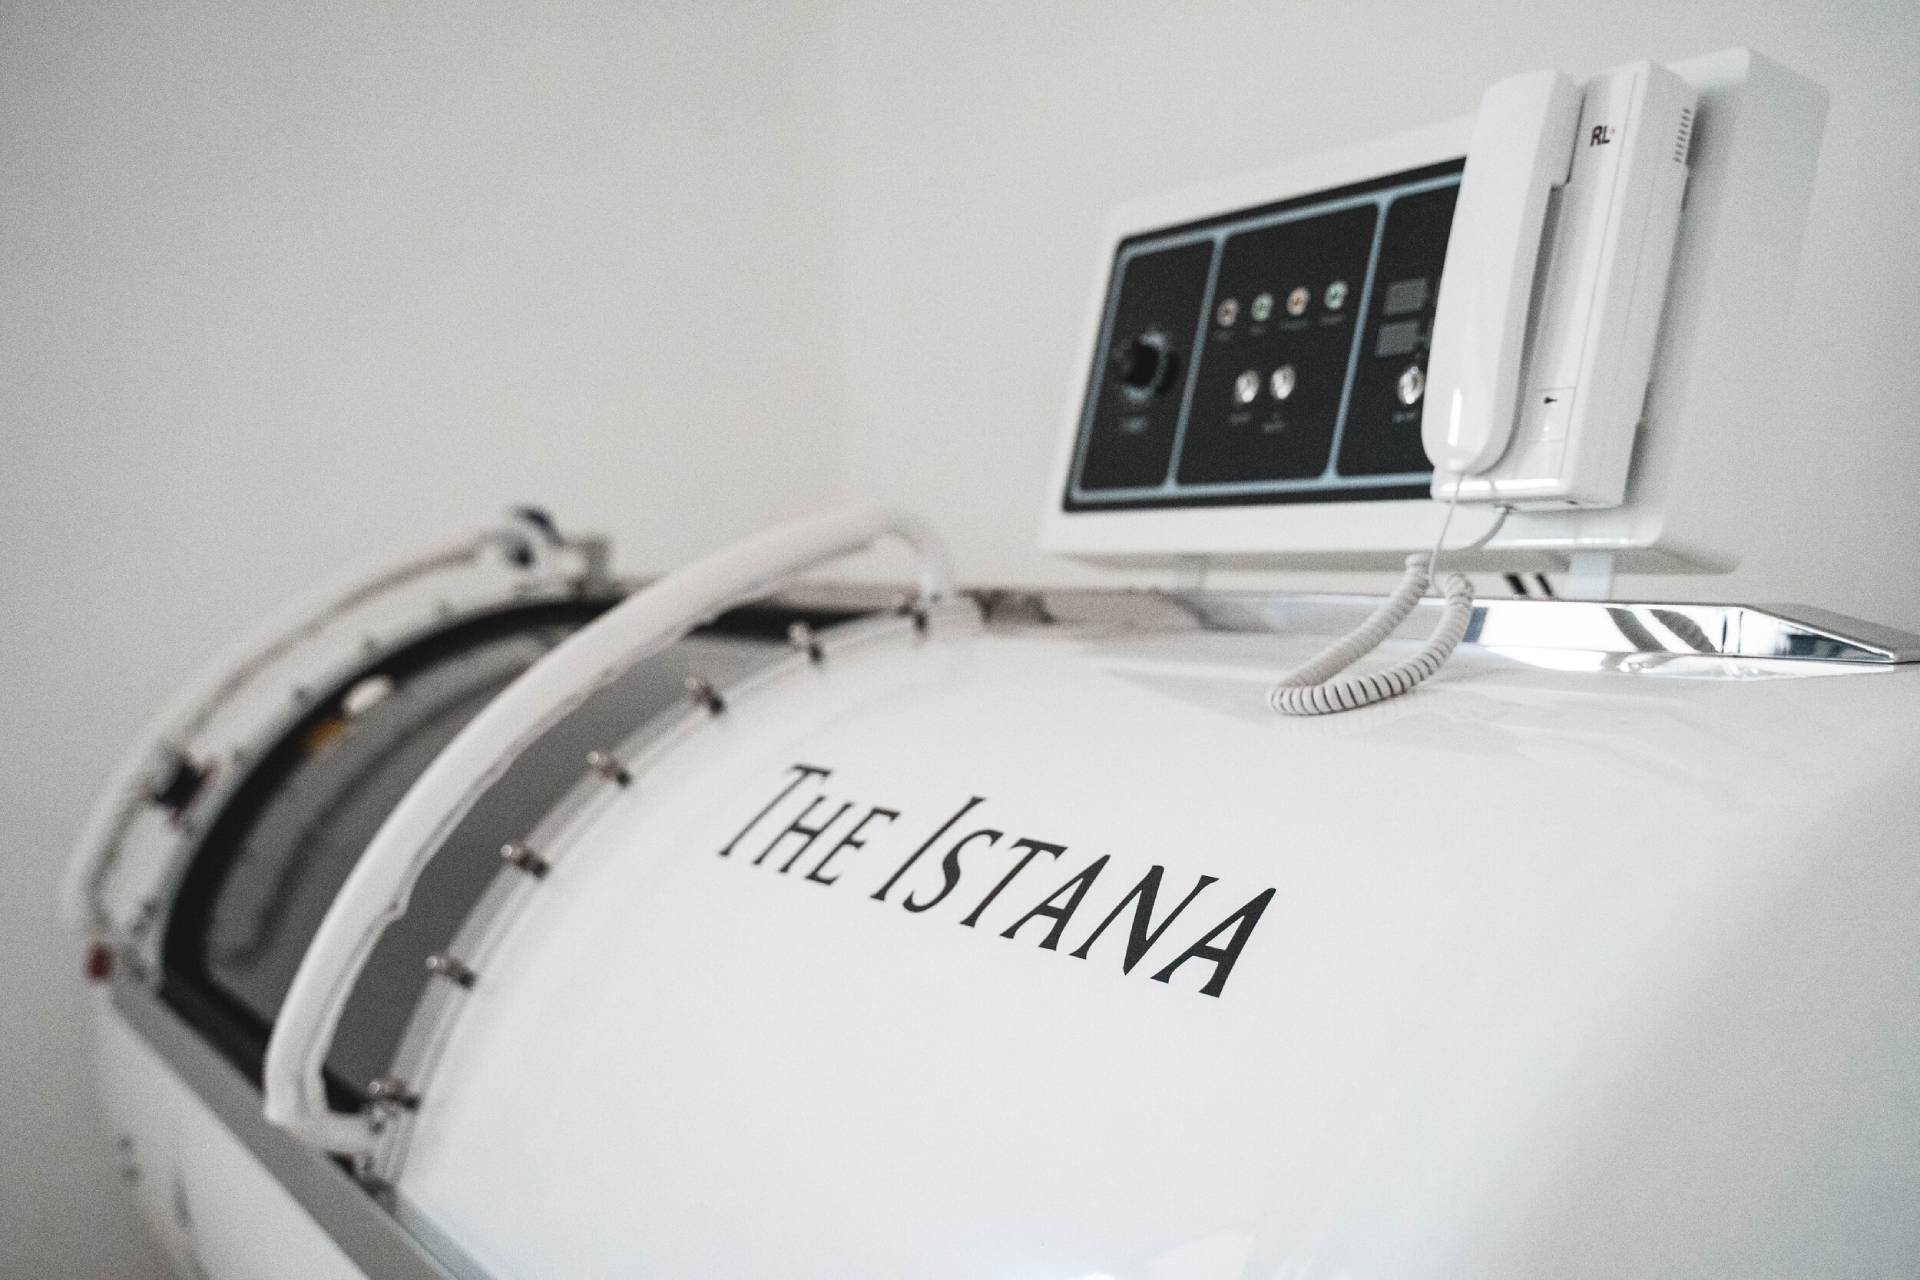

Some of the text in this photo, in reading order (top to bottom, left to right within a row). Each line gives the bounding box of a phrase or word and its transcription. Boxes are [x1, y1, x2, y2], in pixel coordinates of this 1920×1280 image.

[1589, 125, 1611, 147] RL
[718, 763, 1277, 999] THE ISTANA
